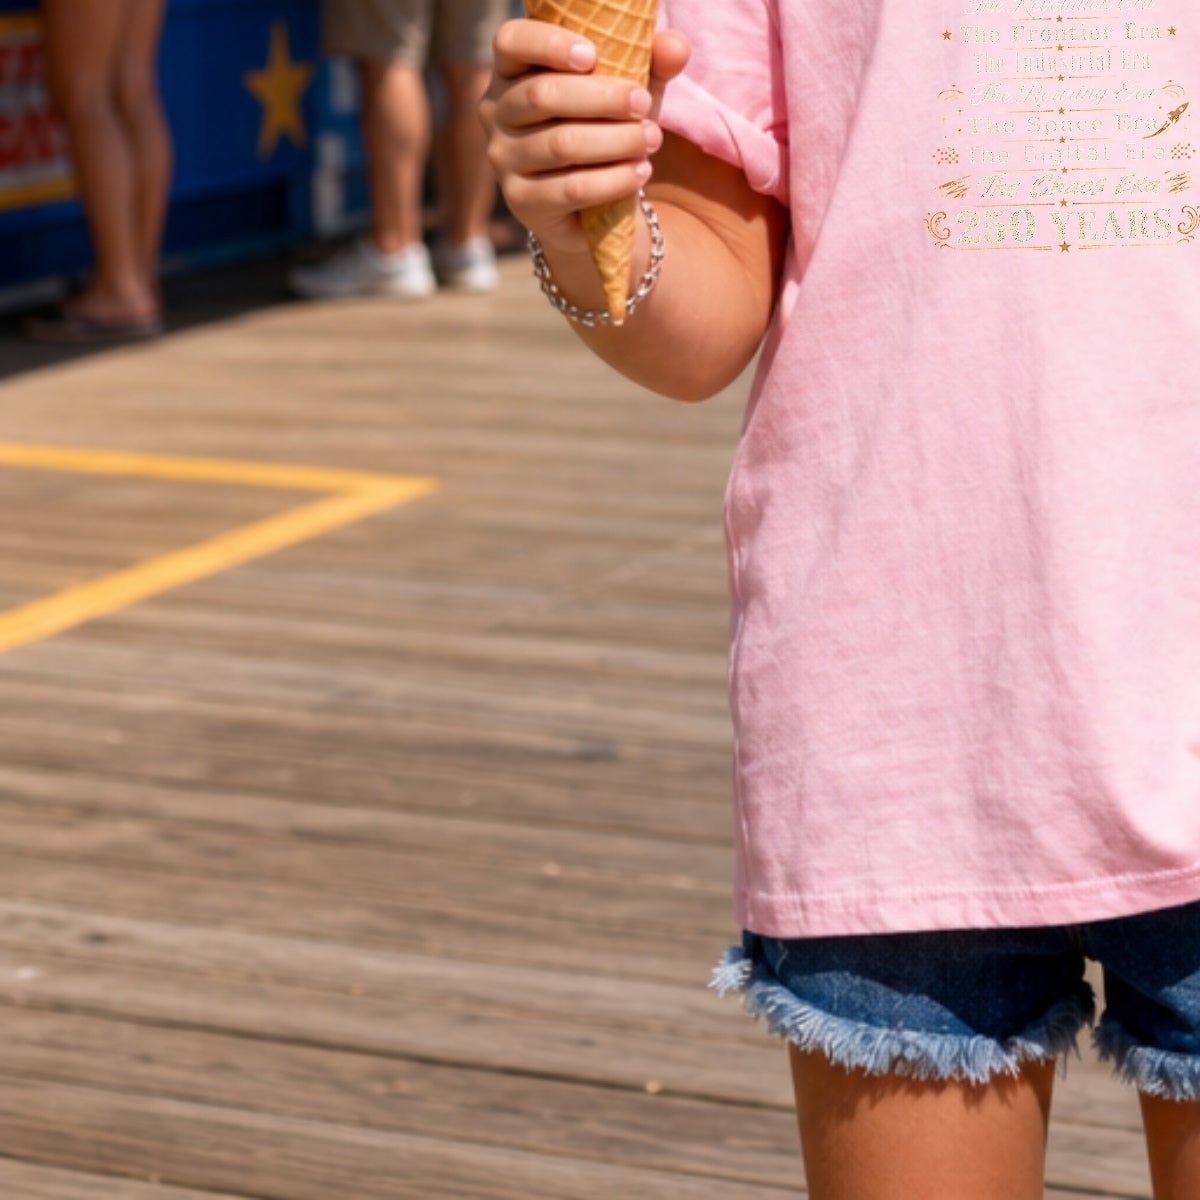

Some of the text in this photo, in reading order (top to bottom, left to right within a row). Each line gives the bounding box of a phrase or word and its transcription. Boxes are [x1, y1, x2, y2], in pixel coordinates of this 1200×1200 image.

[960, 22, 1162, 43] The Frontier Era
[974, 49, 1151, 74] The Industrial Era
[967, 113, 1160, 136] The Space Era
[969, 142, 1167, 167] The Digital Era
[977, 172, 1162, 200] The Chaos Era
[957, 208, 1173, 244] 250 YEARS
